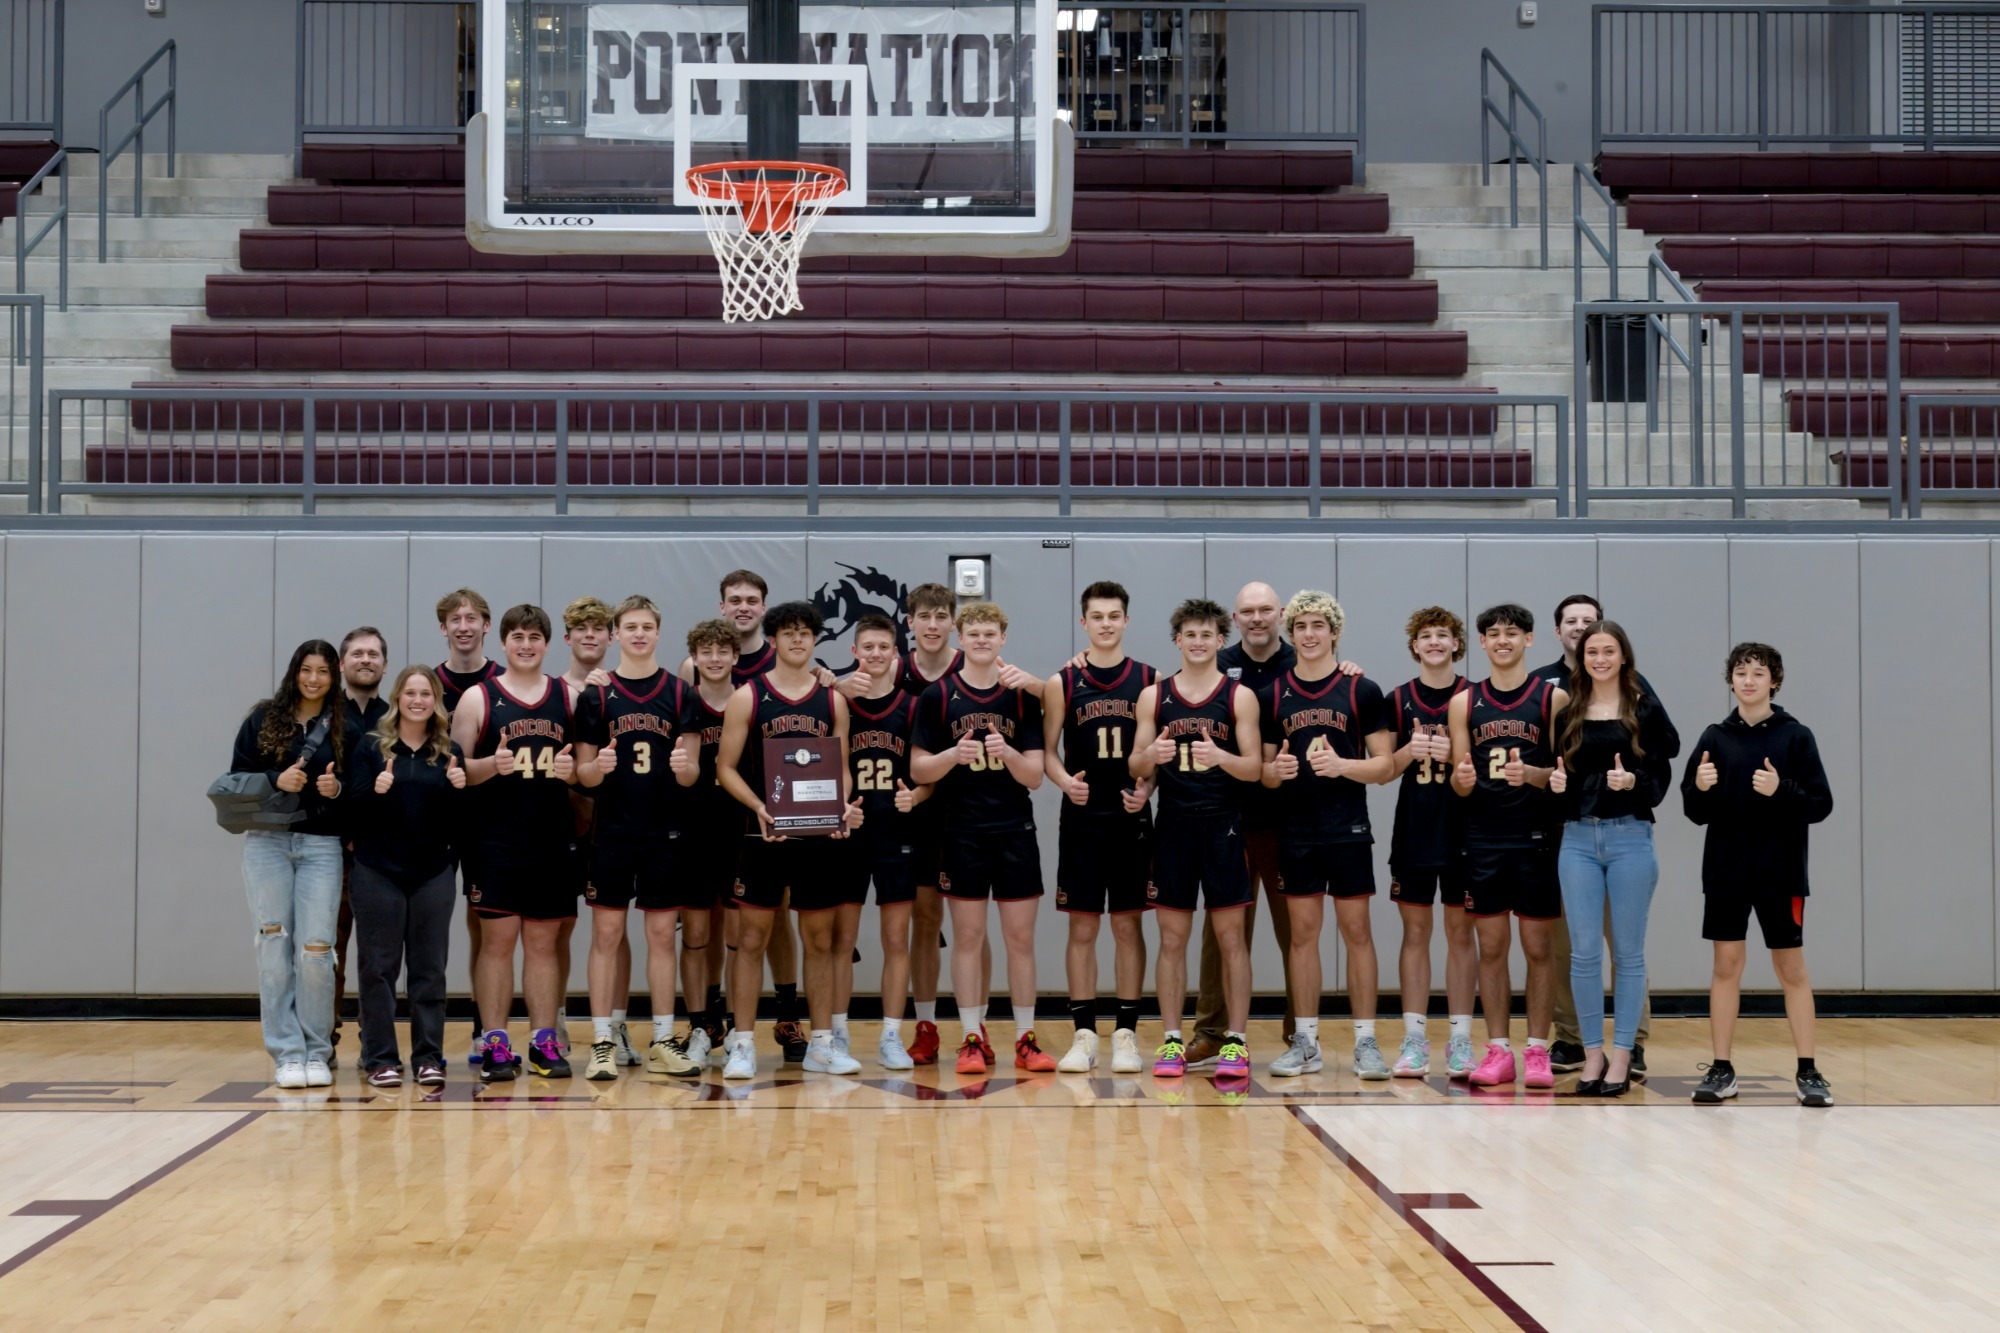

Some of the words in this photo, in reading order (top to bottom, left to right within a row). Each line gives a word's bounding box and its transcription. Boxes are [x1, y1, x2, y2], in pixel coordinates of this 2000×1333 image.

[799, 32, 1036, 117] NATION
[514, 216, 594, 226] AALCO
[608, 712, 672, 739] LINCOLN
[762, 714, 828, 739] LINCOLN
[951, 712, 1015, 740] LINCOLN
[1162, 717, 1229, 741] INCOLN
[1282, 708, 1347, 737] LINCOLN
[1473, 719, 1540, 746] LINCOLN
[1097, 726, 1123, 759] 11
[513, 746, 556, 779] 44
[632, 741, 651, 774] 3
[1178, 743, 1211, 772] 1
[1489, 747, 1521, 780] 2
[857, 758, 894, 791] 22
[774, 819, 793, 827] AREA
[793, 818, 840, 826] CONSOLATION
